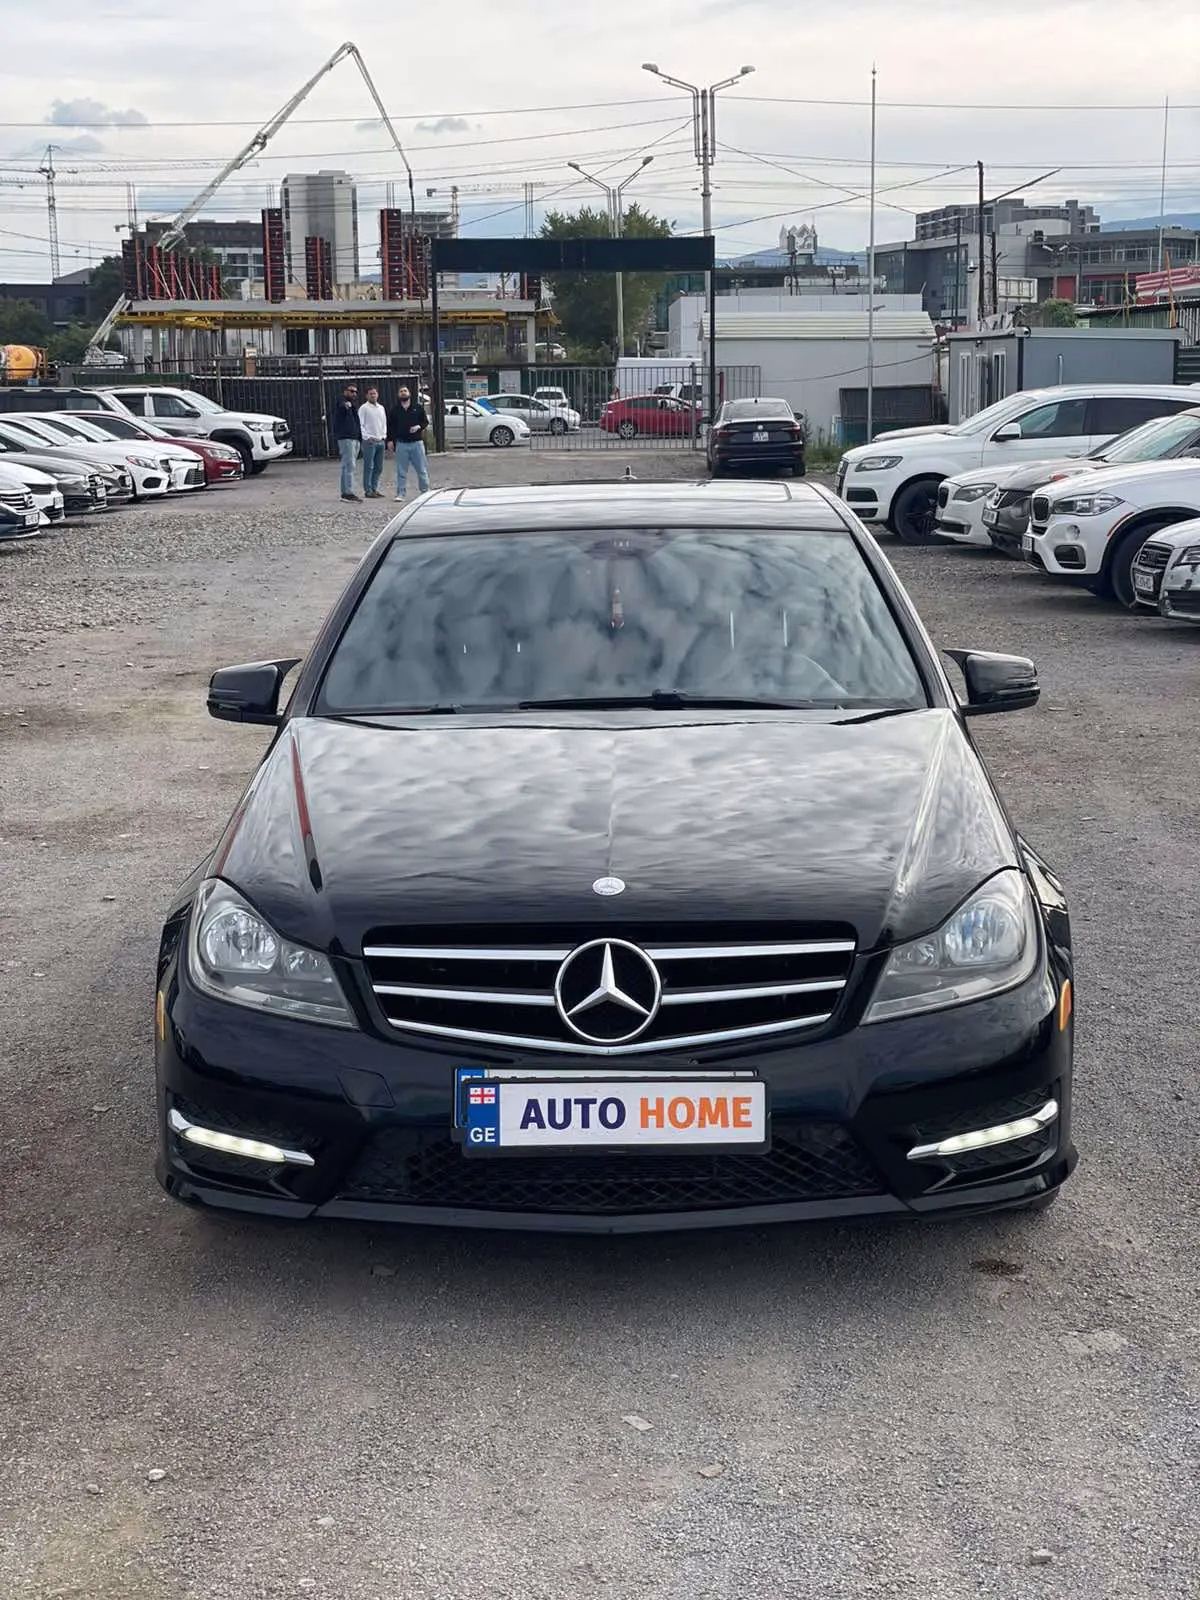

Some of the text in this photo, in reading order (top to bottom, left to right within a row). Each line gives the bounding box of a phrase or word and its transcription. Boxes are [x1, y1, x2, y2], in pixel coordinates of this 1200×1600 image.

[519, 1096, 753, 1130] AUTO HOME
[470, 1127, 496, 1143] GE
